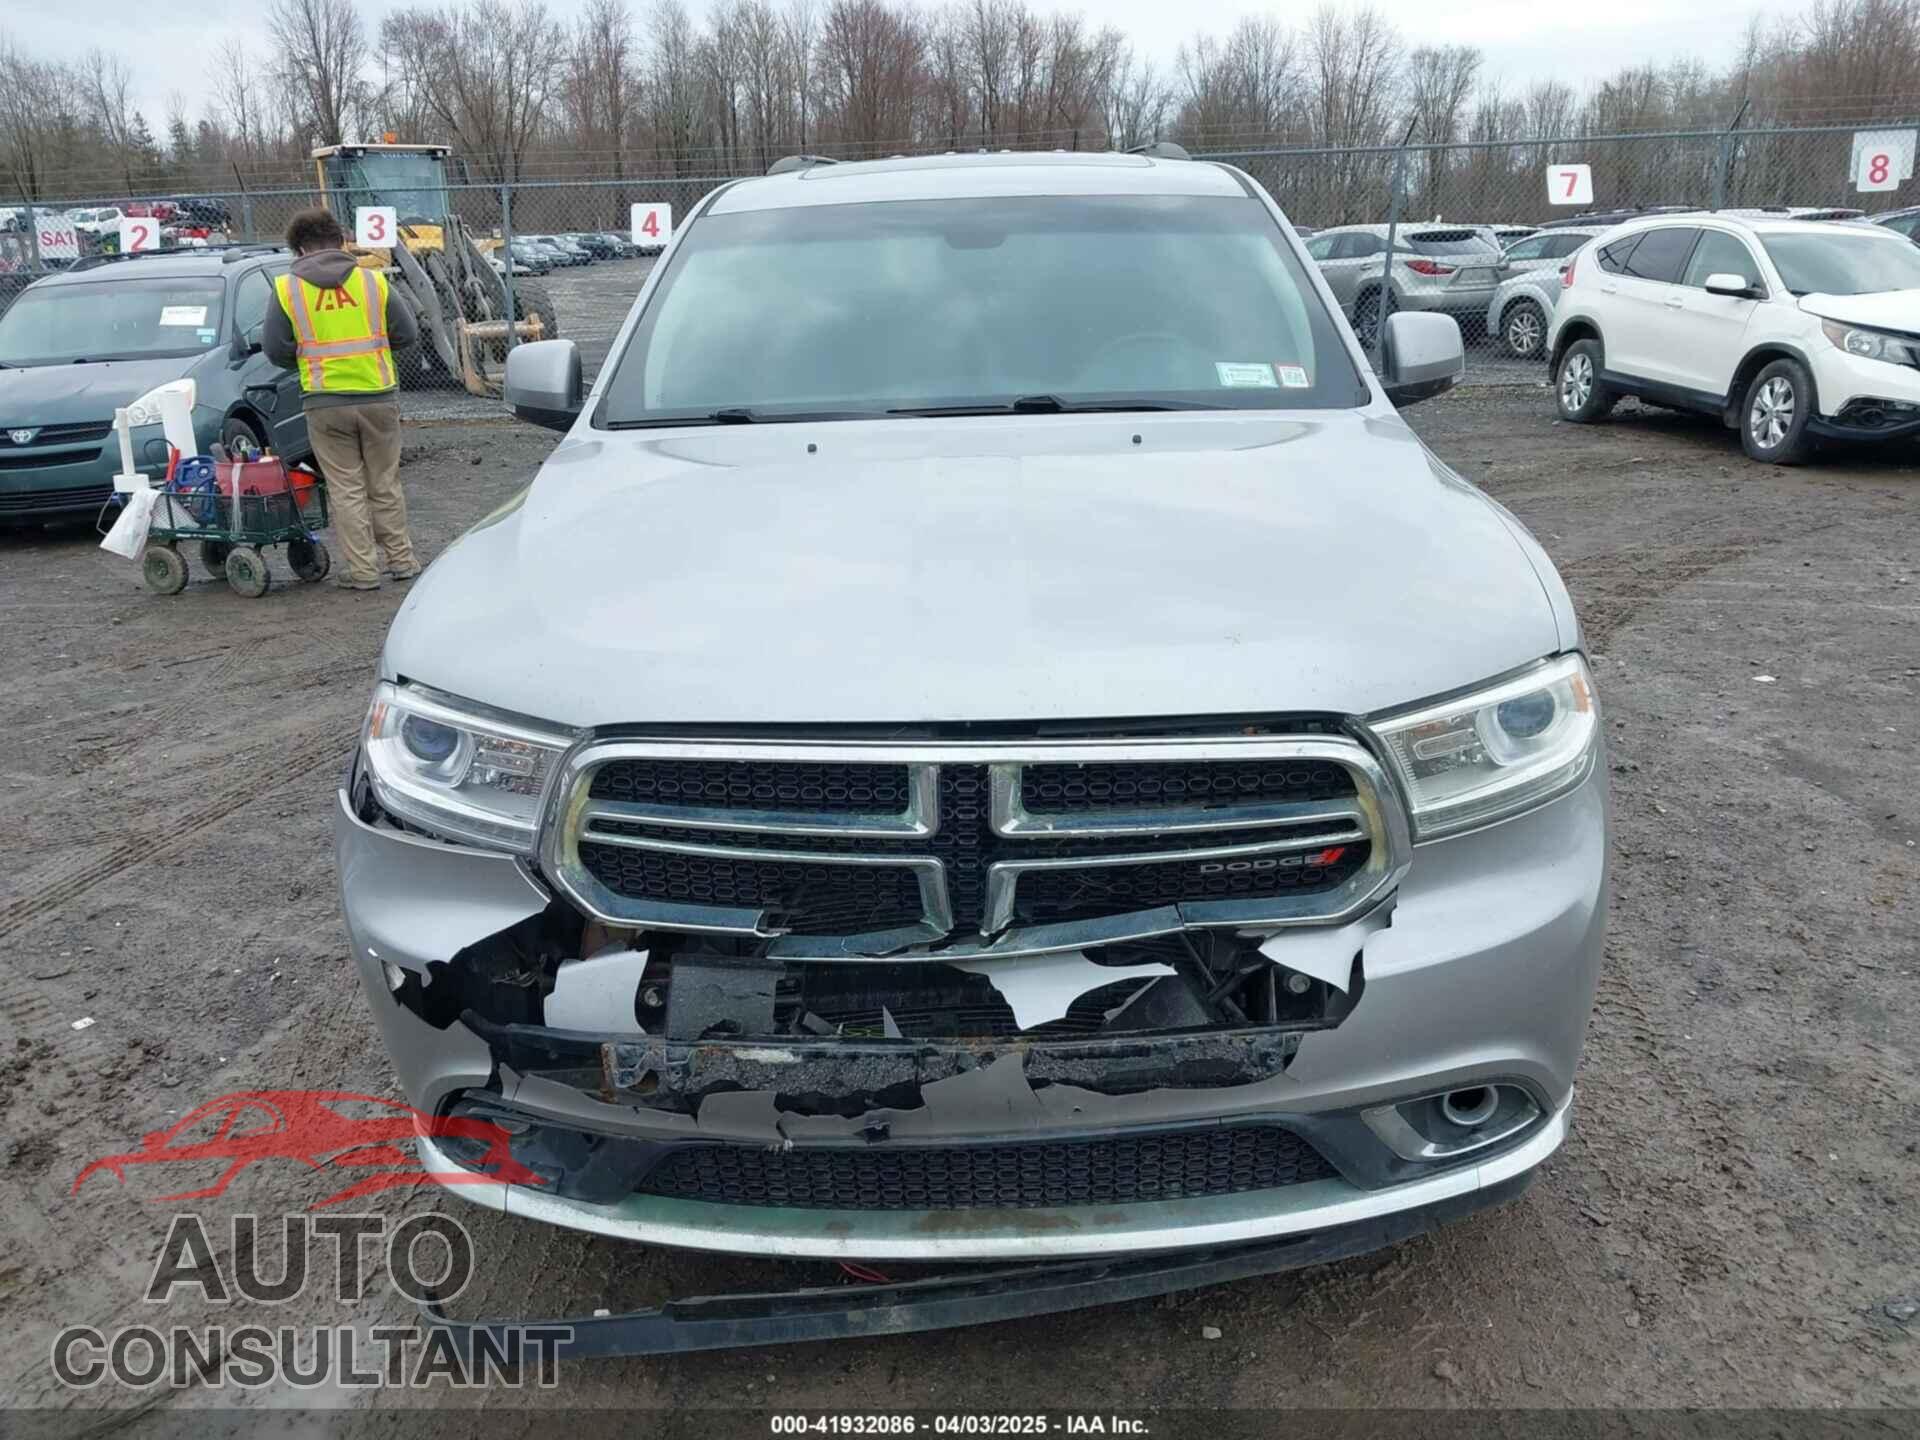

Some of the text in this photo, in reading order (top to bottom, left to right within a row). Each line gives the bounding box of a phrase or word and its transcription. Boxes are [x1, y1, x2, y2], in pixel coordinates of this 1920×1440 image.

[1869, 154, 1889, 184] 8
[1560, 172, 1578, 197] 7
[367, 214, 385, 240] 3
[641, 211, 660, 237] 4
[130, 225, 148, 253] 2
[1200, 855, 1324, 873] DODGE
